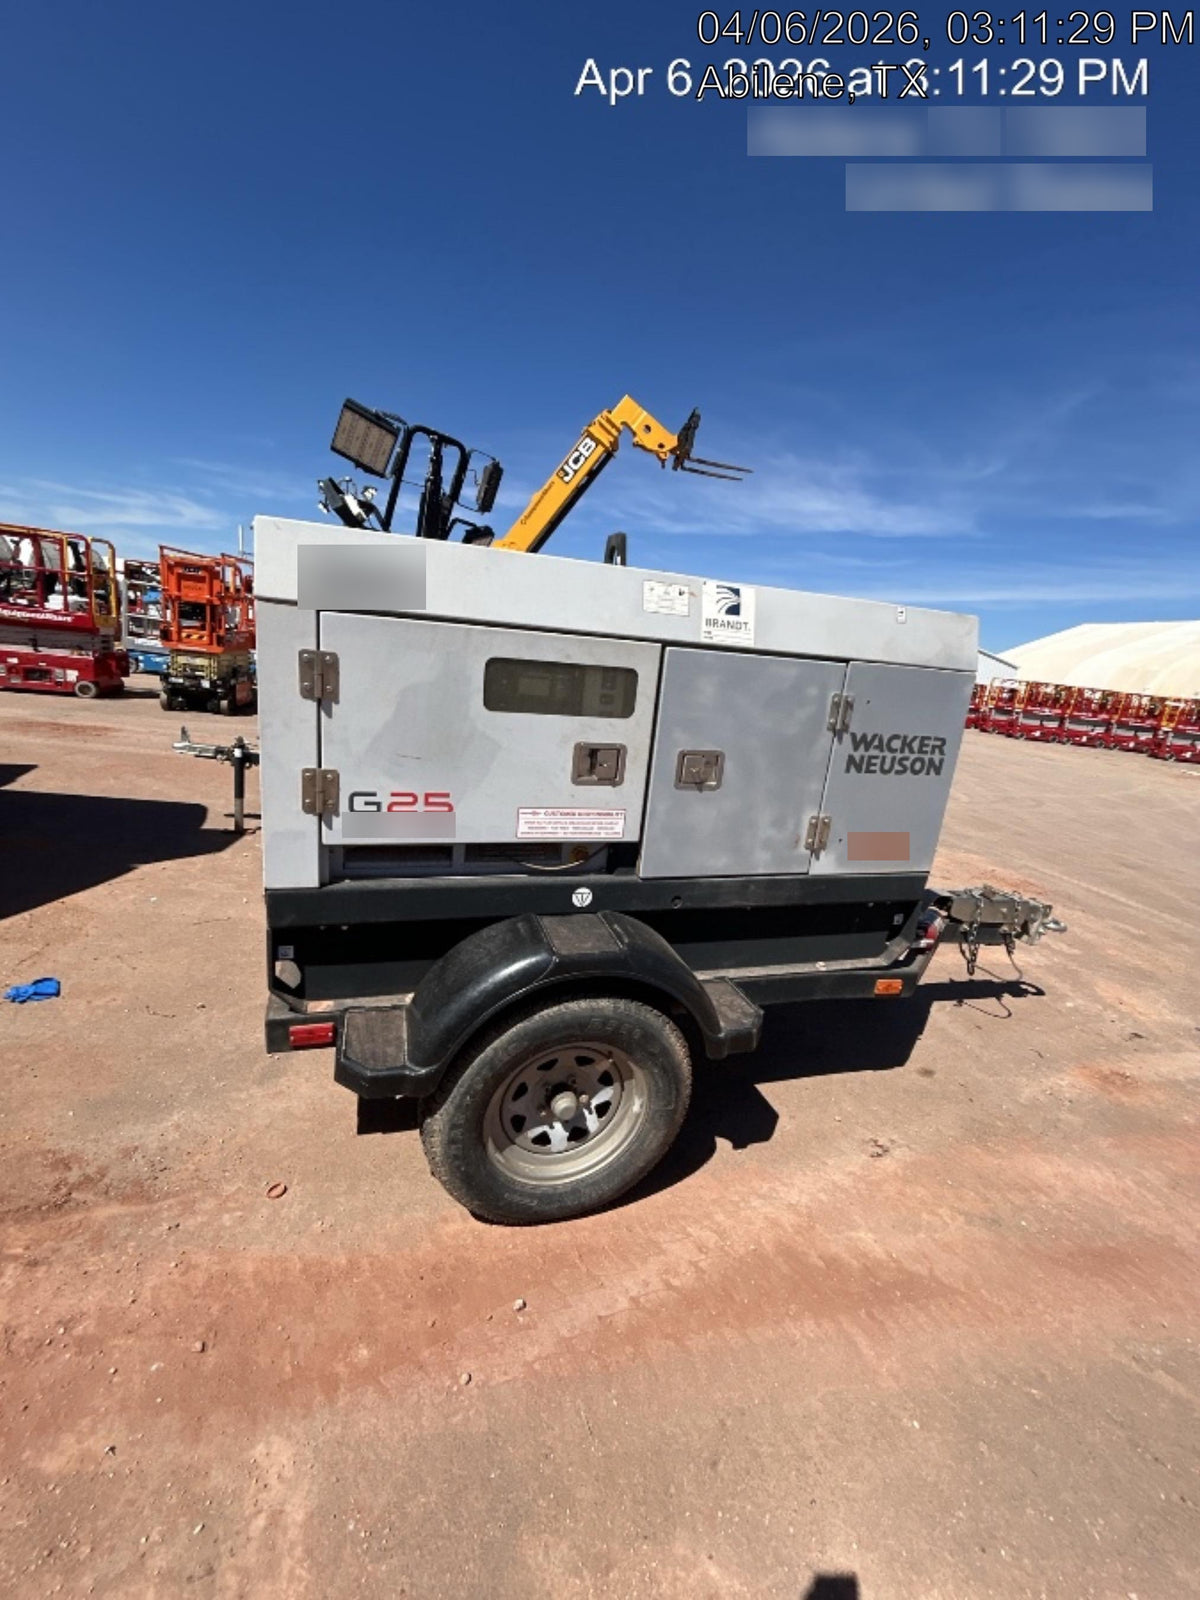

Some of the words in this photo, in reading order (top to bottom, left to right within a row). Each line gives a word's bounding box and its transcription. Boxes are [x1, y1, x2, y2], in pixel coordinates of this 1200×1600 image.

[563, 437, 597, 483] JCB
[850, 732, 947, 756] WACKER
[844, 753, 945, 776] NEUSON
[348, 791, 454, 813] G25
